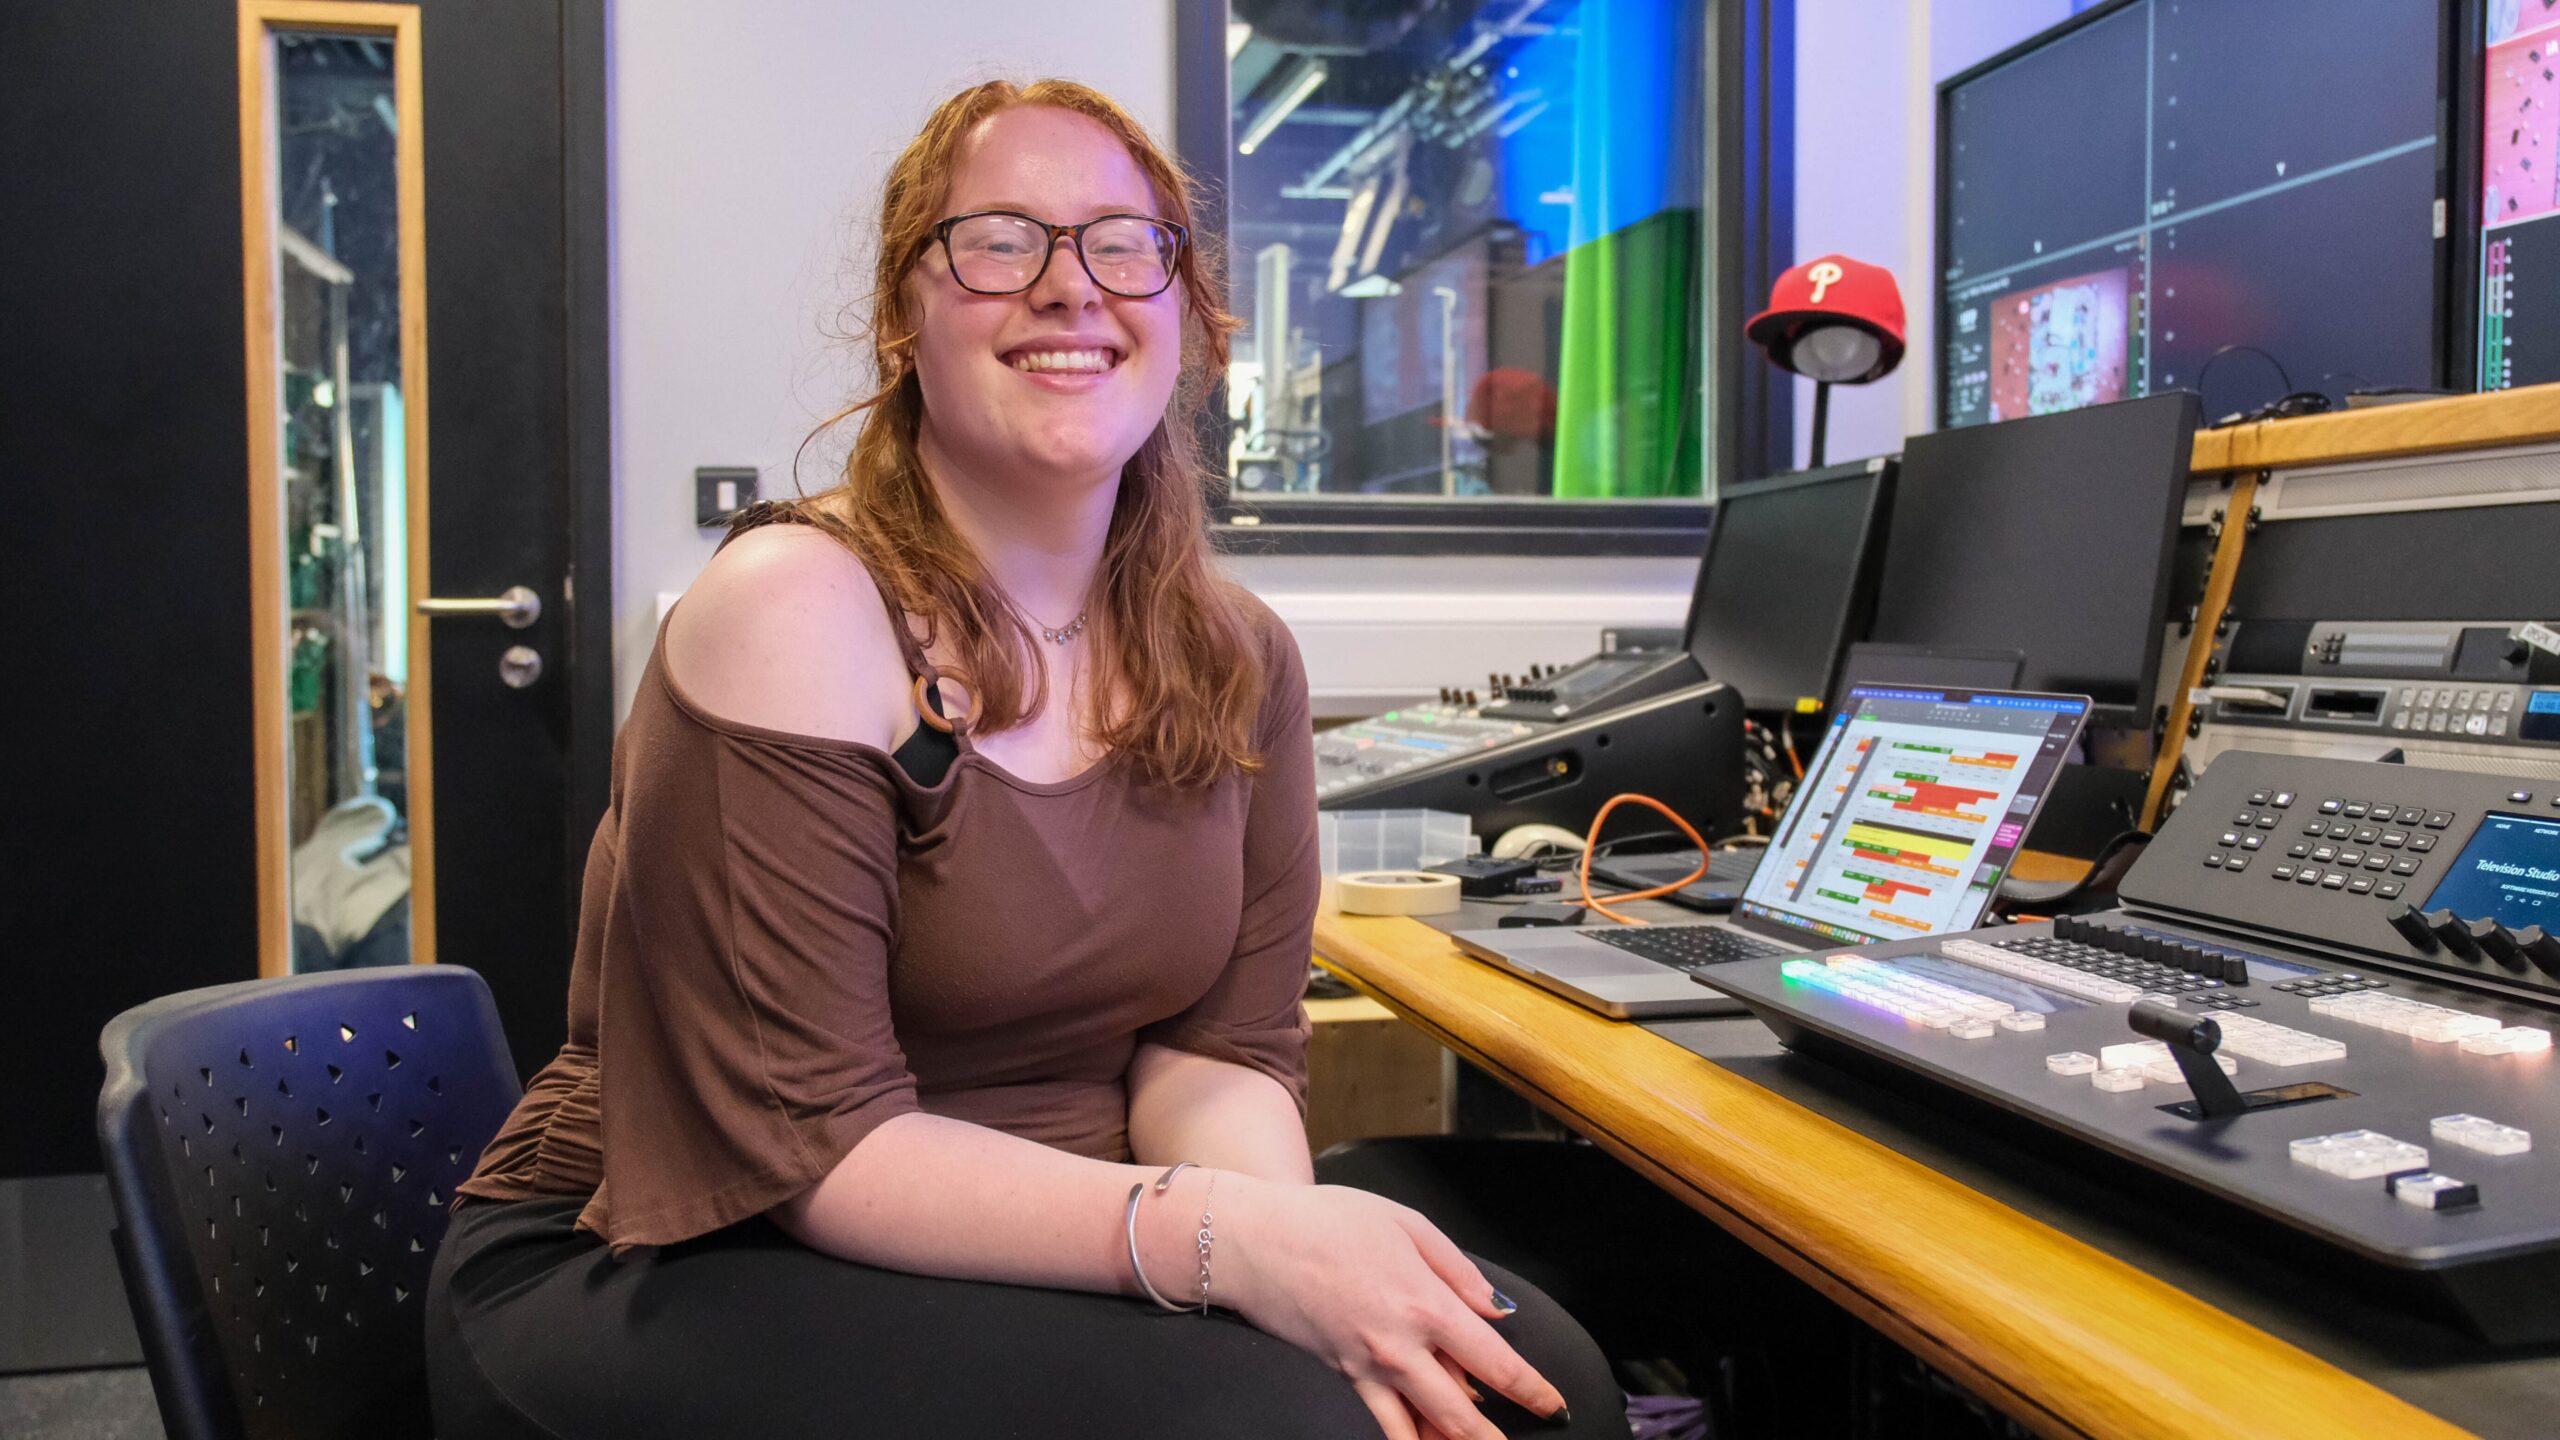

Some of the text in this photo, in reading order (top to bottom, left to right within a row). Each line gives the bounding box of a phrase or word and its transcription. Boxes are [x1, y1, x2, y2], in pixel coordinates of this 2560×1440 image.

[1808, 262, 1843, 304] P
[2476, 859, 2560, 882] Television Studio
